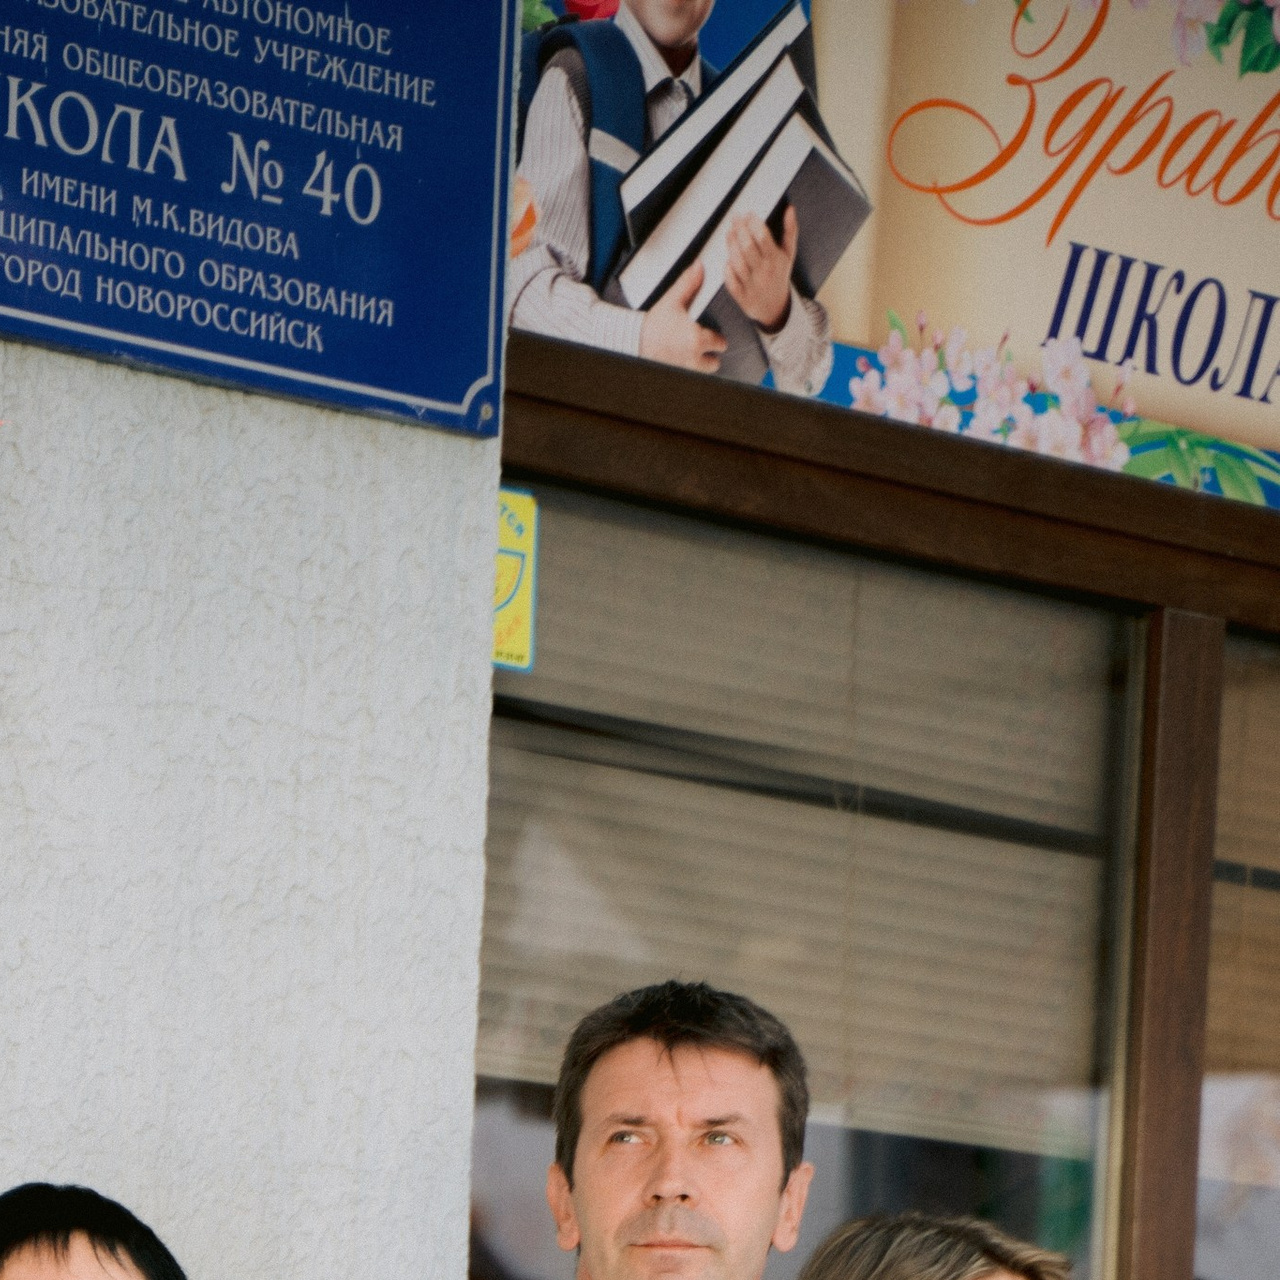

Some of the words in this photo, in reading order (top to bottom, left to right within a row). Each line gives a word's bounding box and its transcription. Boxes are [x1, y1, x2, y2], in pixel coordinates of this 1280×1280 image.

[63, 43, 403, 152] ОБЩЕОБРАЗОВАТЕЛЬНАЯ
[254, 36, 437, 107] УЧРЕЖДЕНИЕ
[22, 167, 117, 217] ИМЕНИ
[131, 194, 300, 260] М.К.ВИДОВА
[302, 150, 382, 226] 40
[96, 275, 324, 353] НОВОРОССИЙСК
[198, 259, 395, 328] ОБРАЗОВАНИЯ
[1041, 241, 1280, 403] ШКОЛ
